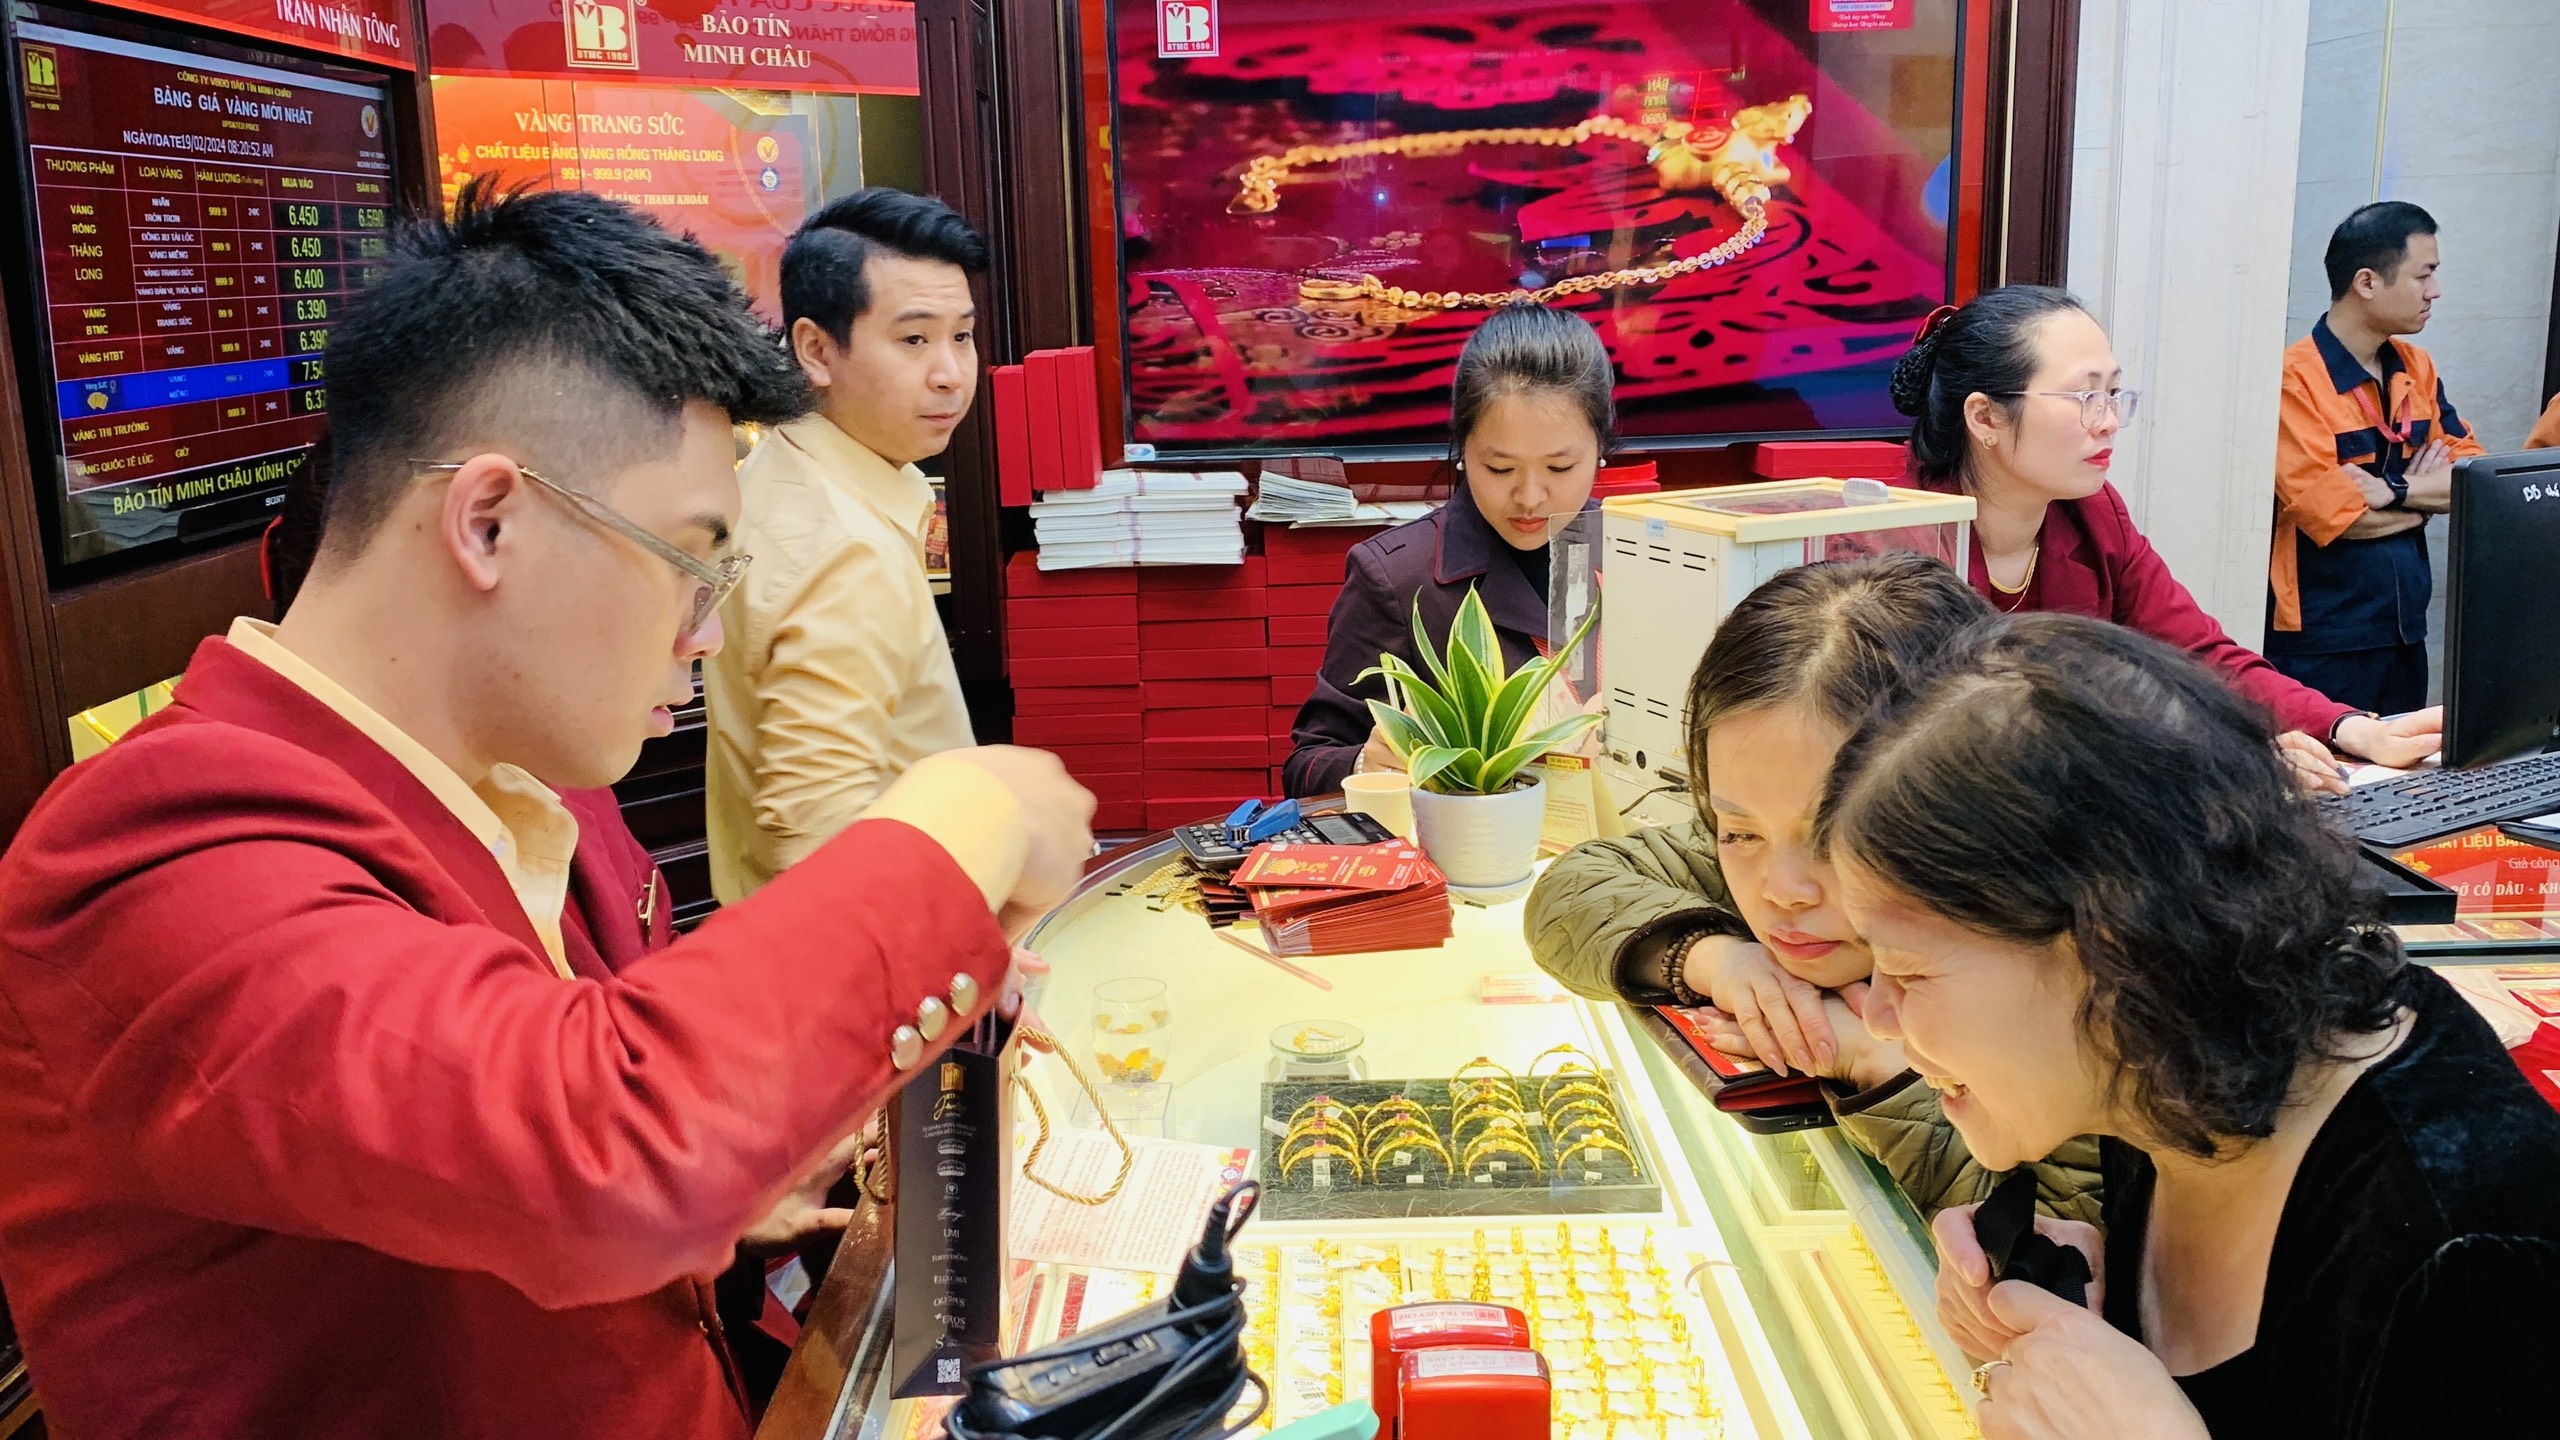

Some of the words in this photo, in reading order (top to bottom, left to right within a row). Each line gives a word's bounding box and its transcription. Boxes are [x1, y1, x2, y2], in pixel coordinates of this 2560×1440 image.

[318, 3, 362, 39] NHÂN
[363, 12, 400, 48] TÔNG
[701, 10, 748, 35] BẢO
[753, 13, 790, 38] TÍN
[577, 51, 603, 60] BTMC
[606, 52, 628, 62] 1989
[684, 43, 745, 66] MINH
[750, 45, 811, 69] CHÂU
[154, 84, 192, 108] BẢNG
[198, 92, 221, 112] GIÁ
[225, 95, 259, 117] VÀNG
[261, 101, 282, 122] MỚI
[514, 107, 572, 133] VÀNG
[577, 113, 642, 135] TRANG
[648, 111, 685, 136] SỨC
[228, 139, 260, 157] 08:20:52
[262, 143, 274, 158] AM
[475, 140, 510, 158] CHẤT
[512, 143, 540, 161] LIỆU
[580, 144, 614, 160] VÀNG
[652, 145, 691, 162] THĂNG
[692, 150, 724, 163] LONG
[139, 166, 158, 179] LOẠI
[159, 165, 183, 179] VÀNG
[197, 171, 214, 182] HÀM
[282, 178, 298, 188] MUA
[593, 168, 622, 181] 999.9
[623, 168, 652, 184] (24K)
[70, 203, 94, 216] VÀNG
[208, 206, 228, 216] 999.9
[248, 207, 260, 216] 24K
[288, 205, 318, 226] 6.450
[69, 243, 103, 258] THĂNG
[251, 242, 262, 250] 24K
[291, 237, 322, 258] 6.450
[74, 268, 103, 280] LONG
[254, 276, 266, 284] 24K
[294, 268, 324, 290] 6.400
[83, 306, 106, 319] VÀNG
[162, 301, 182, 311] VÀNG
[256, 306, 268, 315] 24K
[297, 299, 327, 320] 6.390
[86, 325, 108, 336] BTMC
[78, 352, 102, 364] VÀNG
[104, 351, 124, 361] HTBT
[166, 345, 185, 356] VÀNG
[260, 340, 272, 348] 24K
[72, 428, 97, 442] VÀNG
[266, 402, 278, 410] 24K
[76, 463, 100, 477] VÀNG
[113, 486, 146, 516] BẢO
[148, 479, 173, 507] TÍN
[176, 476, 215, 501] MINH
[217, 466, 252, 492] CHÂU
[254, 461, 284, 484] KÍNH
[2462, 833, 2493, 850] LIỆU
[2508, 857, 2528, 870] Giá
[2530, 856, 2560, 870] công
[2473, 881, 2491, 896] CÔ
[2496, 880, 2524, 896] DÂU
